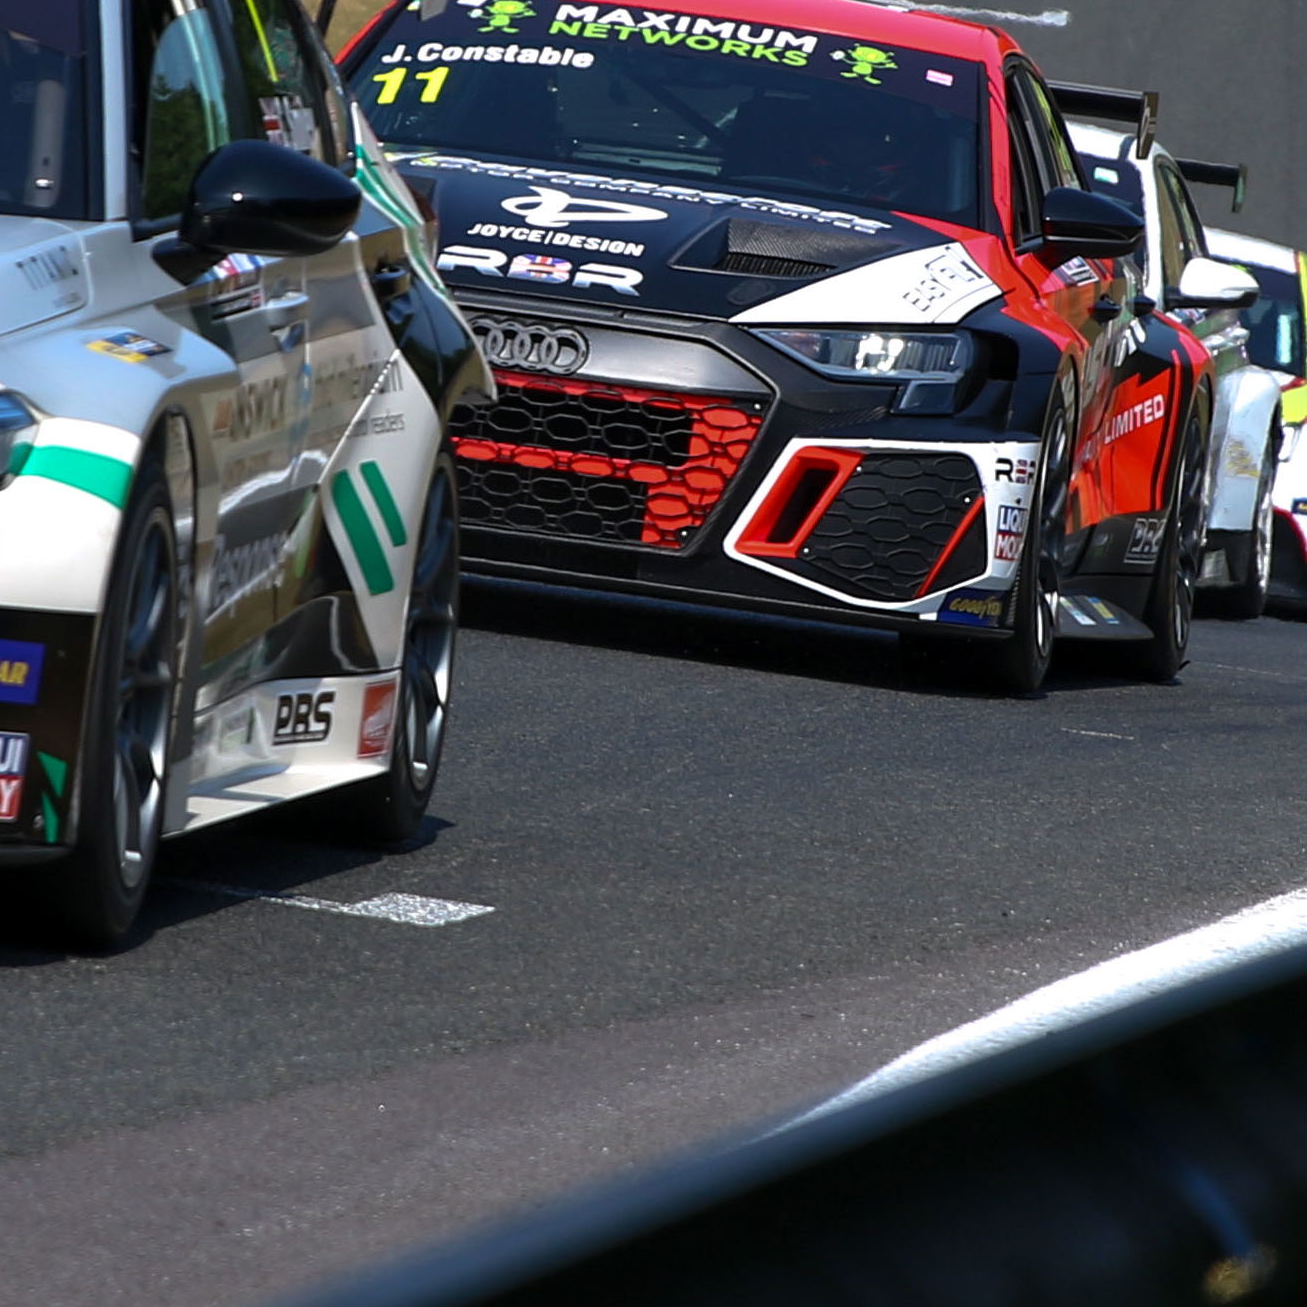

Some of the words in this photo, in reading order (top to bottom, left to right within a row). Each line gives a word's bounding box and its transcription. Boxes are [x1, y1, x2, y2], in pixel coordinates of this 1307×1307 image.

[548, 20, 809, 67] NETWORKS
[555, 4, 819, 54] MAXIMUM
[381, 44, 413, 63] J.
[417, 42, 596, 68] Constable
[372, 66, 450, 105] 11
[436, 245, 644, 297] RBR
[1103, 393, 1166, 445] LIMITED
